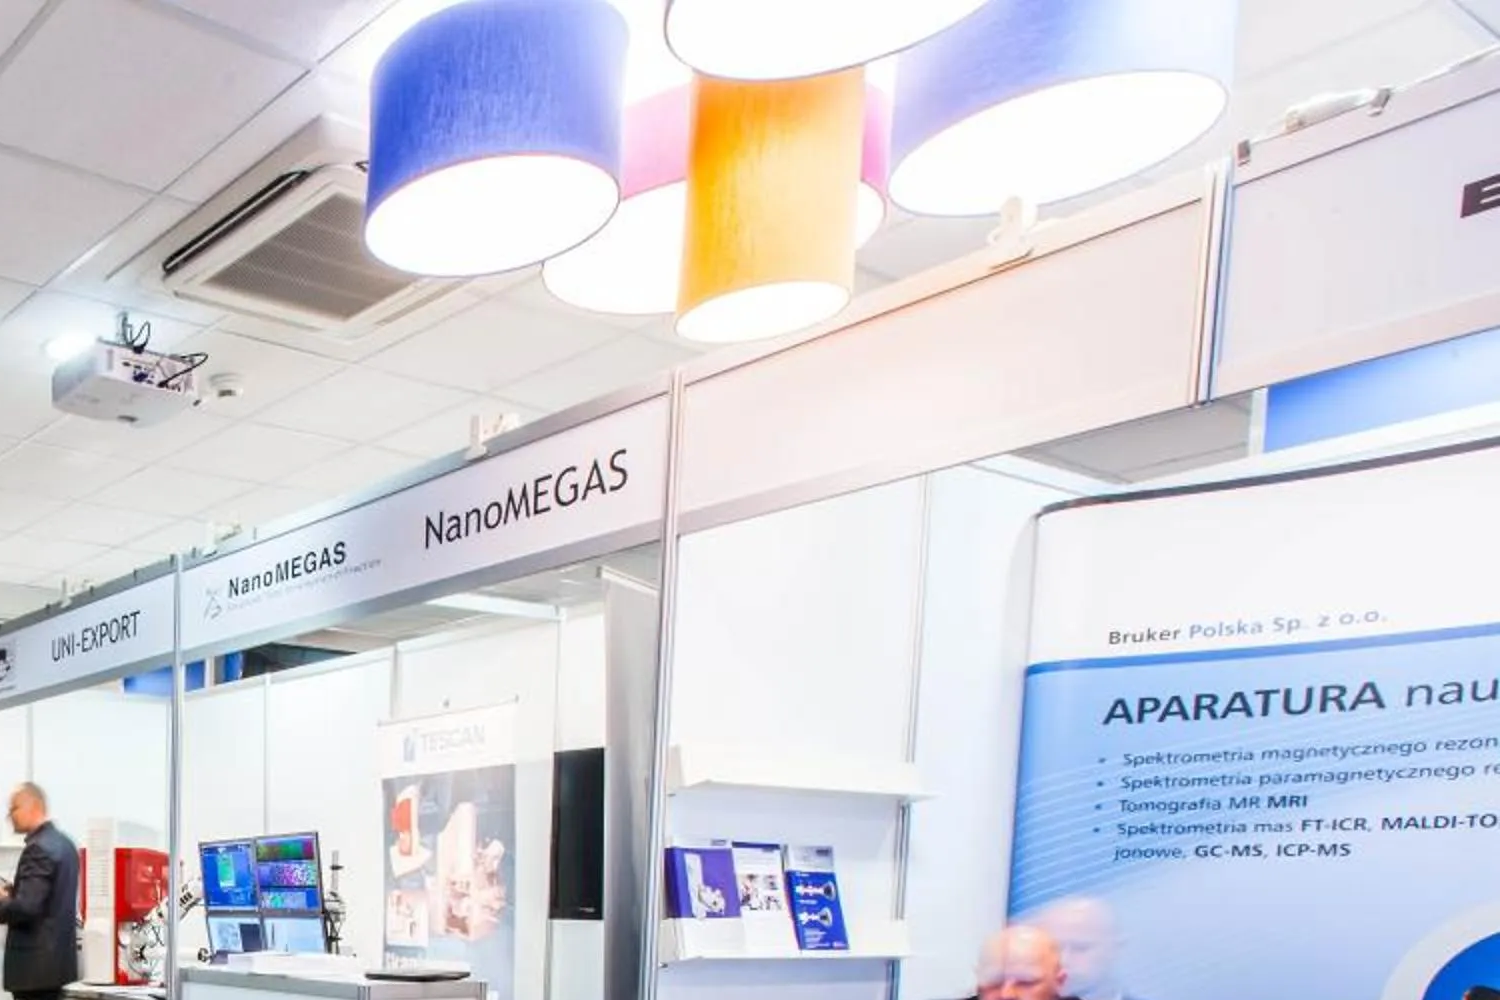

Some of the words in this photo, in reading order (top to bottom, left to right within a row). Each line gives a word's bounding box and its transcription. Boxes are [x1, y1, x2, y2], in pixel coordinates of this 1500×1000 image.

[424, 449, 629, 549] NanoMEGAS
[228, 540, 347, 598] NanoMEGAS
[51, 610, 141, 661] UNI-EXPORT
[1108, 627, 1181, 645] Bruker
[1188, 619, 1263, 639] Polska
[1318, 614, 1330, 628] z
[1338, 610, 1388, 626] o.o.
[1102, 681, 1386, 725] APARATURA
[1406, 677, 1500, 707] nau
[1123, 746, 1254, 767] Spektrometria
[1261, 740, 1427, 763] magnetycznego
[1435, 736, 1499, 751] rezon
[1120, 771, 1251, 791] Spektrometria
[1259, 764, 1475, 787] paramagnetycznego
[1119, 796, 1221, 815] Tomografia
[1228, 796, 1261, 809] MR
[1267, 795, 1308, 809] MRI
[1117, 820, 1247, 838] Spektrometria
[1254, 823, 1293, 833] mas
[1276, 842, 1351, 857] ICP-MS
